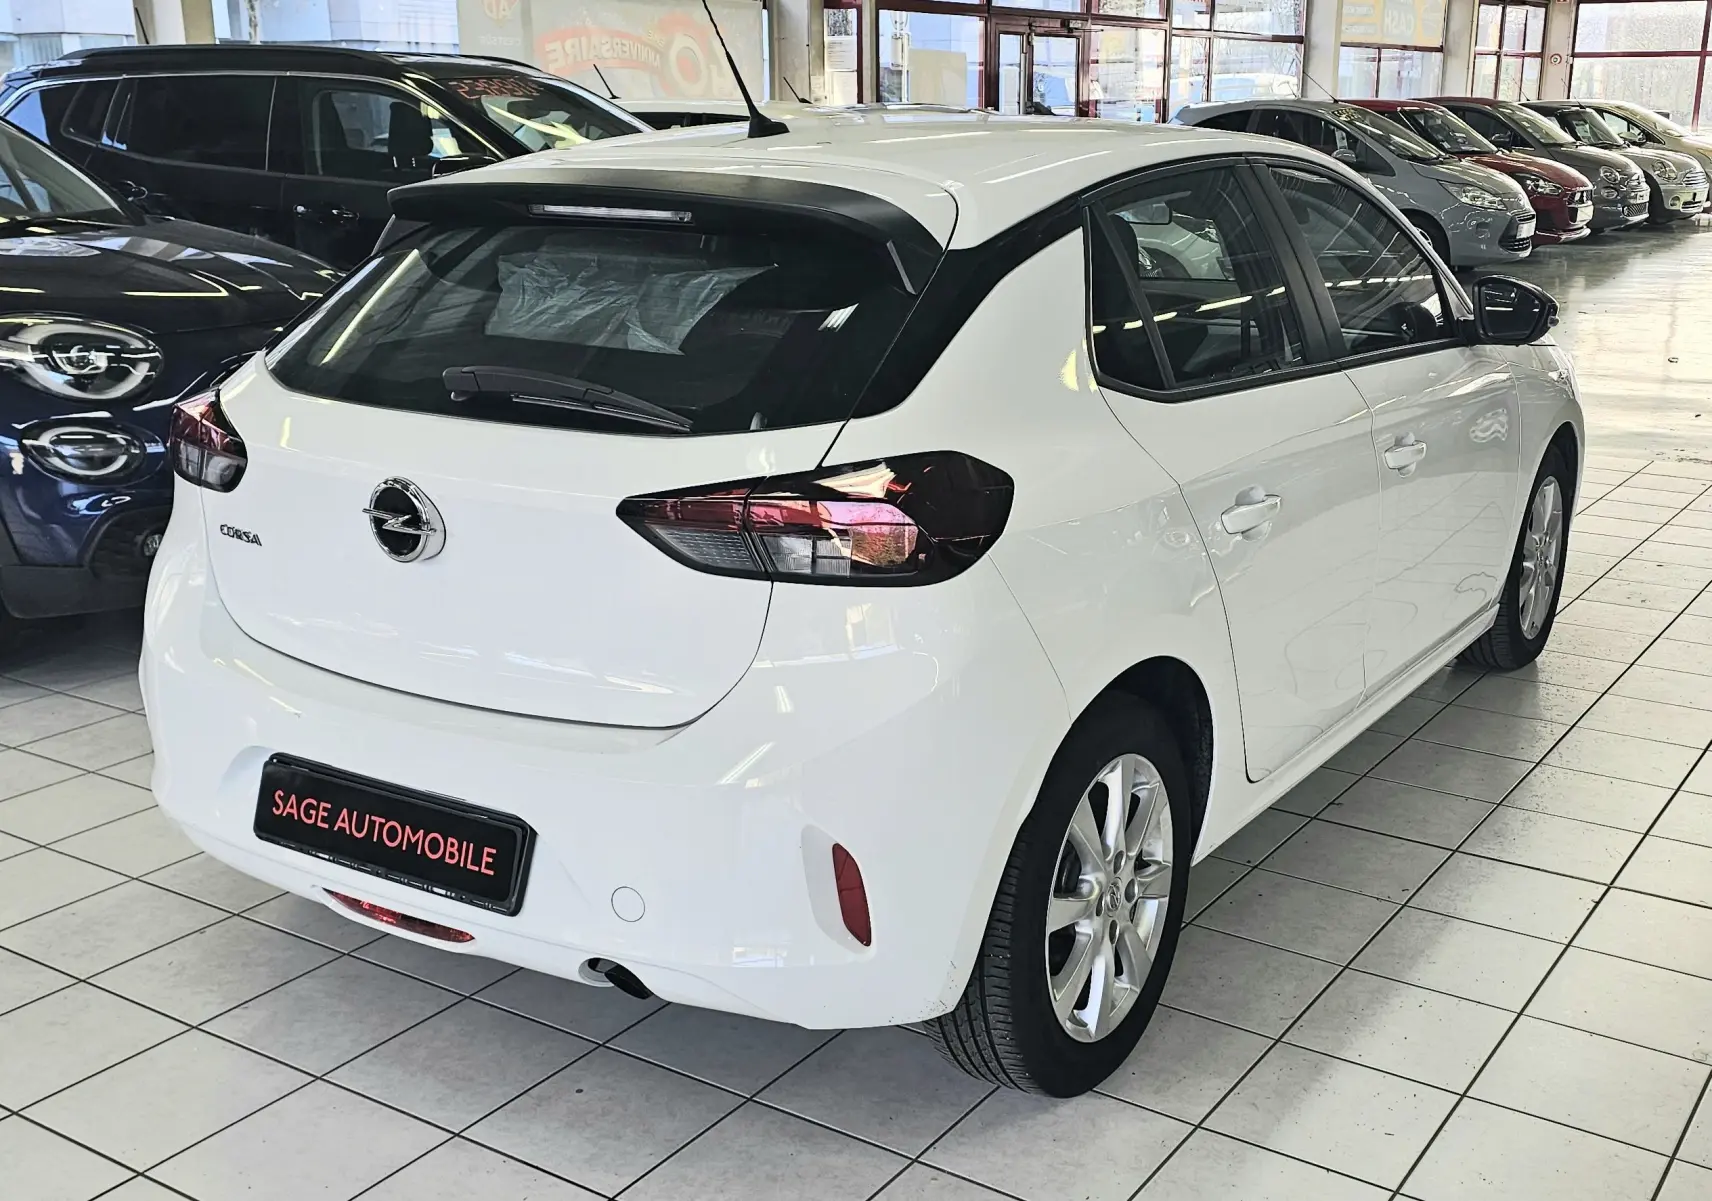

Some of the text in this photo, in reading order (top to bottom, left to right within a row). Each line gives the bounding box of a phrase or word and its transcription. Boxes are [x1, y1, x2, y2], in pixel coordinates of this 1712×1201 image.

[220, 524, 262, 546] CORSA
[272, 789, 497, 876] SAGE AUTOMOBILE
